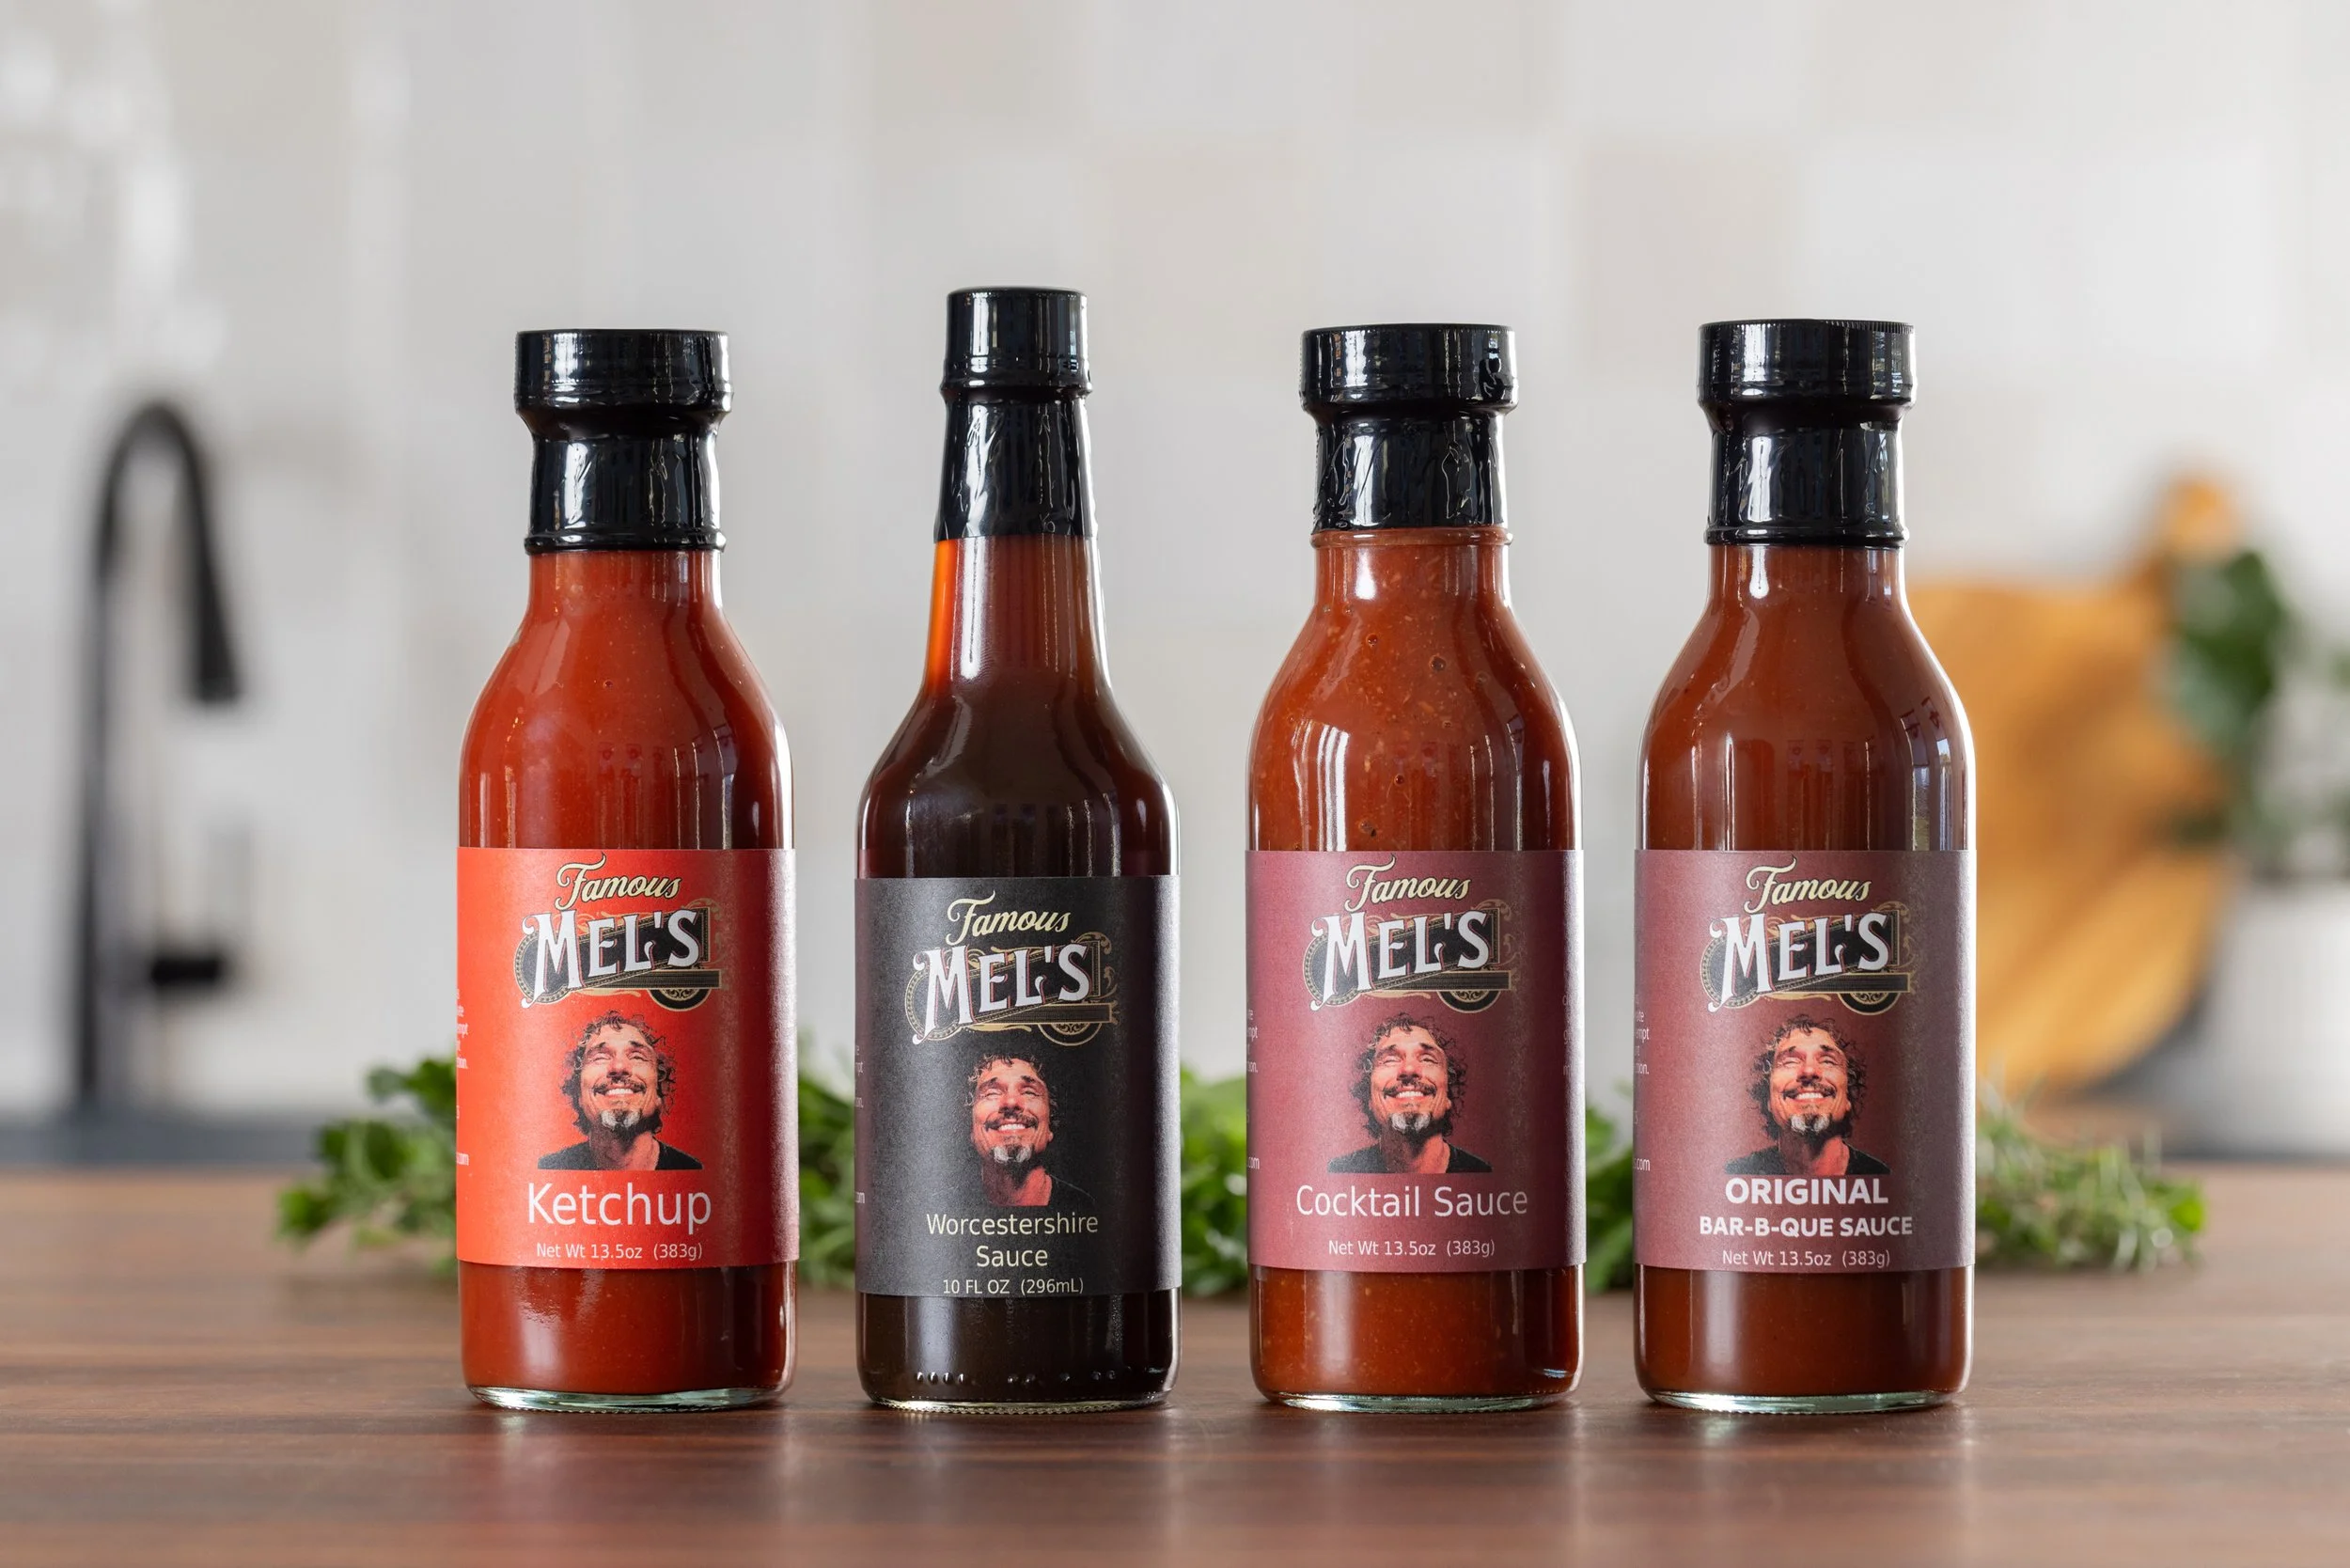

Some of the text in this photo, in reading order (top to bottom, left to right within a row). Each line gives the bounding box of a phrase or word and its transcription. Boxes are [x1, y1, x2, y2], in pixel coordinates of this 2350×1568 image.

[555, 852, 682, 910] Famous
[1344, 854, 1471, 912] Famous
[1743, 856, 1872, 913] Famous
[945, 889, 1072, 947] Famous
[521, 908, 702, 1009] MEL'S
[1309, 909, 1492, 1011] MEL'S
[1706, 912, 1891, 1013] MEL'S
[912, 943, 1092, 1045] MEL'S
[528, 1182, 712, 1234] Ketchup
[1296, 1184, 1528, 1217] Cocktail Sauce
[1725, 1178, 1888, 1205] ORIGINAL
[926, 1212, 1099, 1235] Worcestershire
[1700, 1215, 1913, 1238] BAR-B-QUE SAUCE
[537, 1242, 703, 1262] Net Wt 13.5oz (383g)
[976, 1245, 1049, 1268] Sauce
[1328, 1239, 1496, 1258] Net Wt 13.5oz (383g)
[1722, 1249, 1890, 1268] Net Wt 13.5oz (383g)
[943, 1277, 1085, 1296] 10 FL OZ (296mL)
